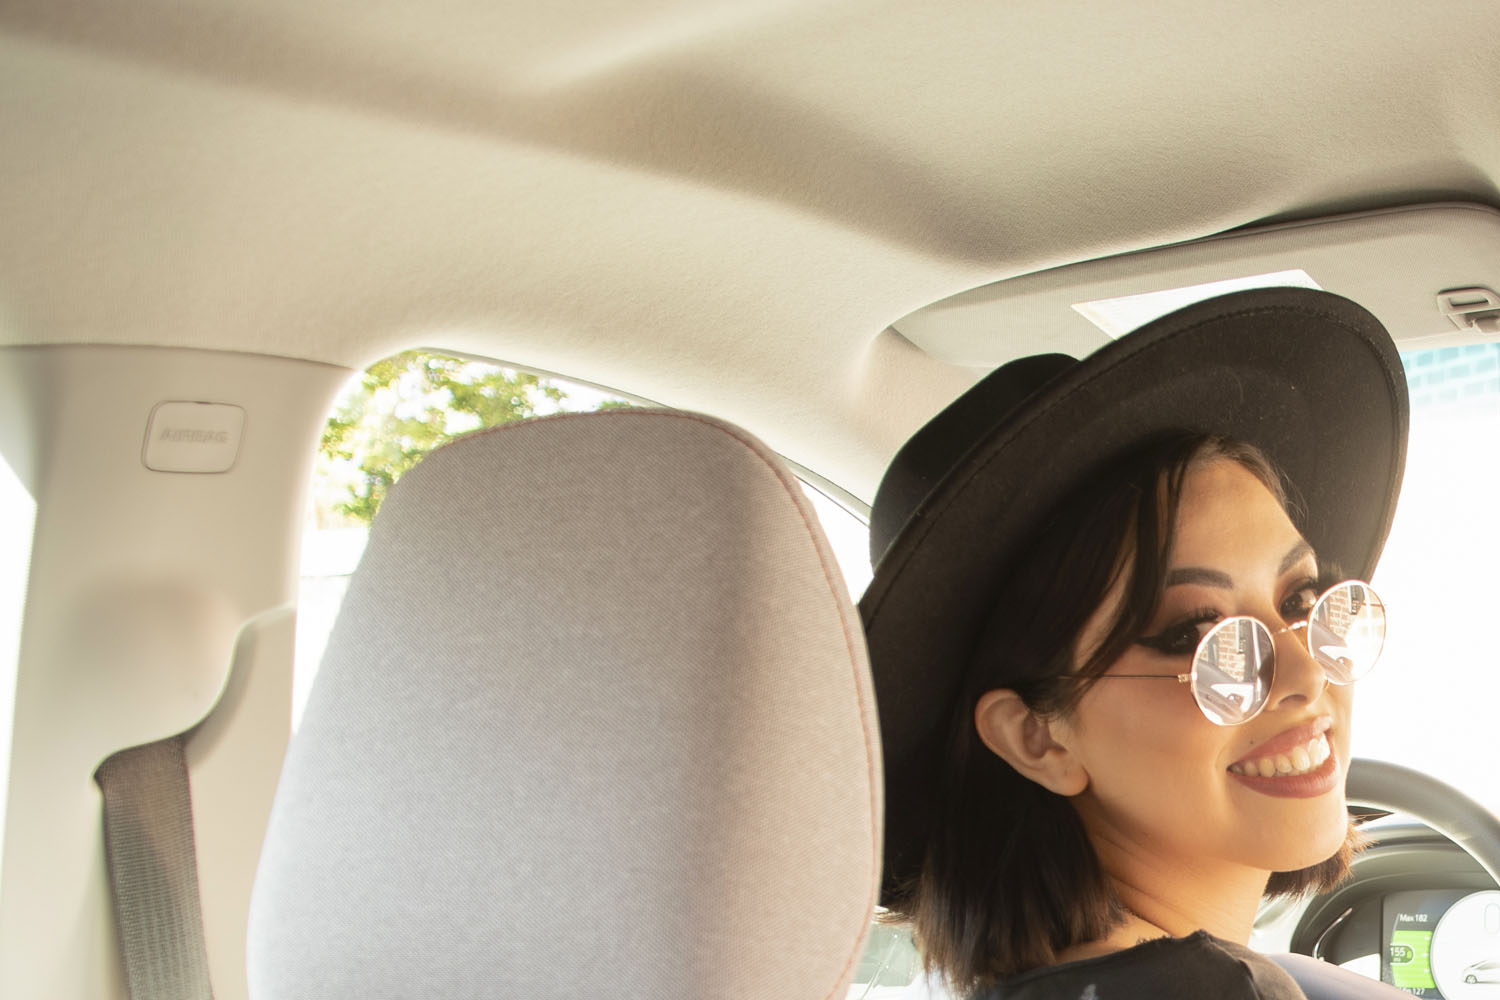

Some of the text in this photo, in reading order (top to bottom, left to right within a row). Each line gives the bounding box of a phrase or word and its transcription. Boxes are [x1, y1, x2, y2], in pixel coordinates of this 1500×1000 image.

[1399, 913, 1428, 922] Max 182
[1390, 948, 1406, 957] 155
